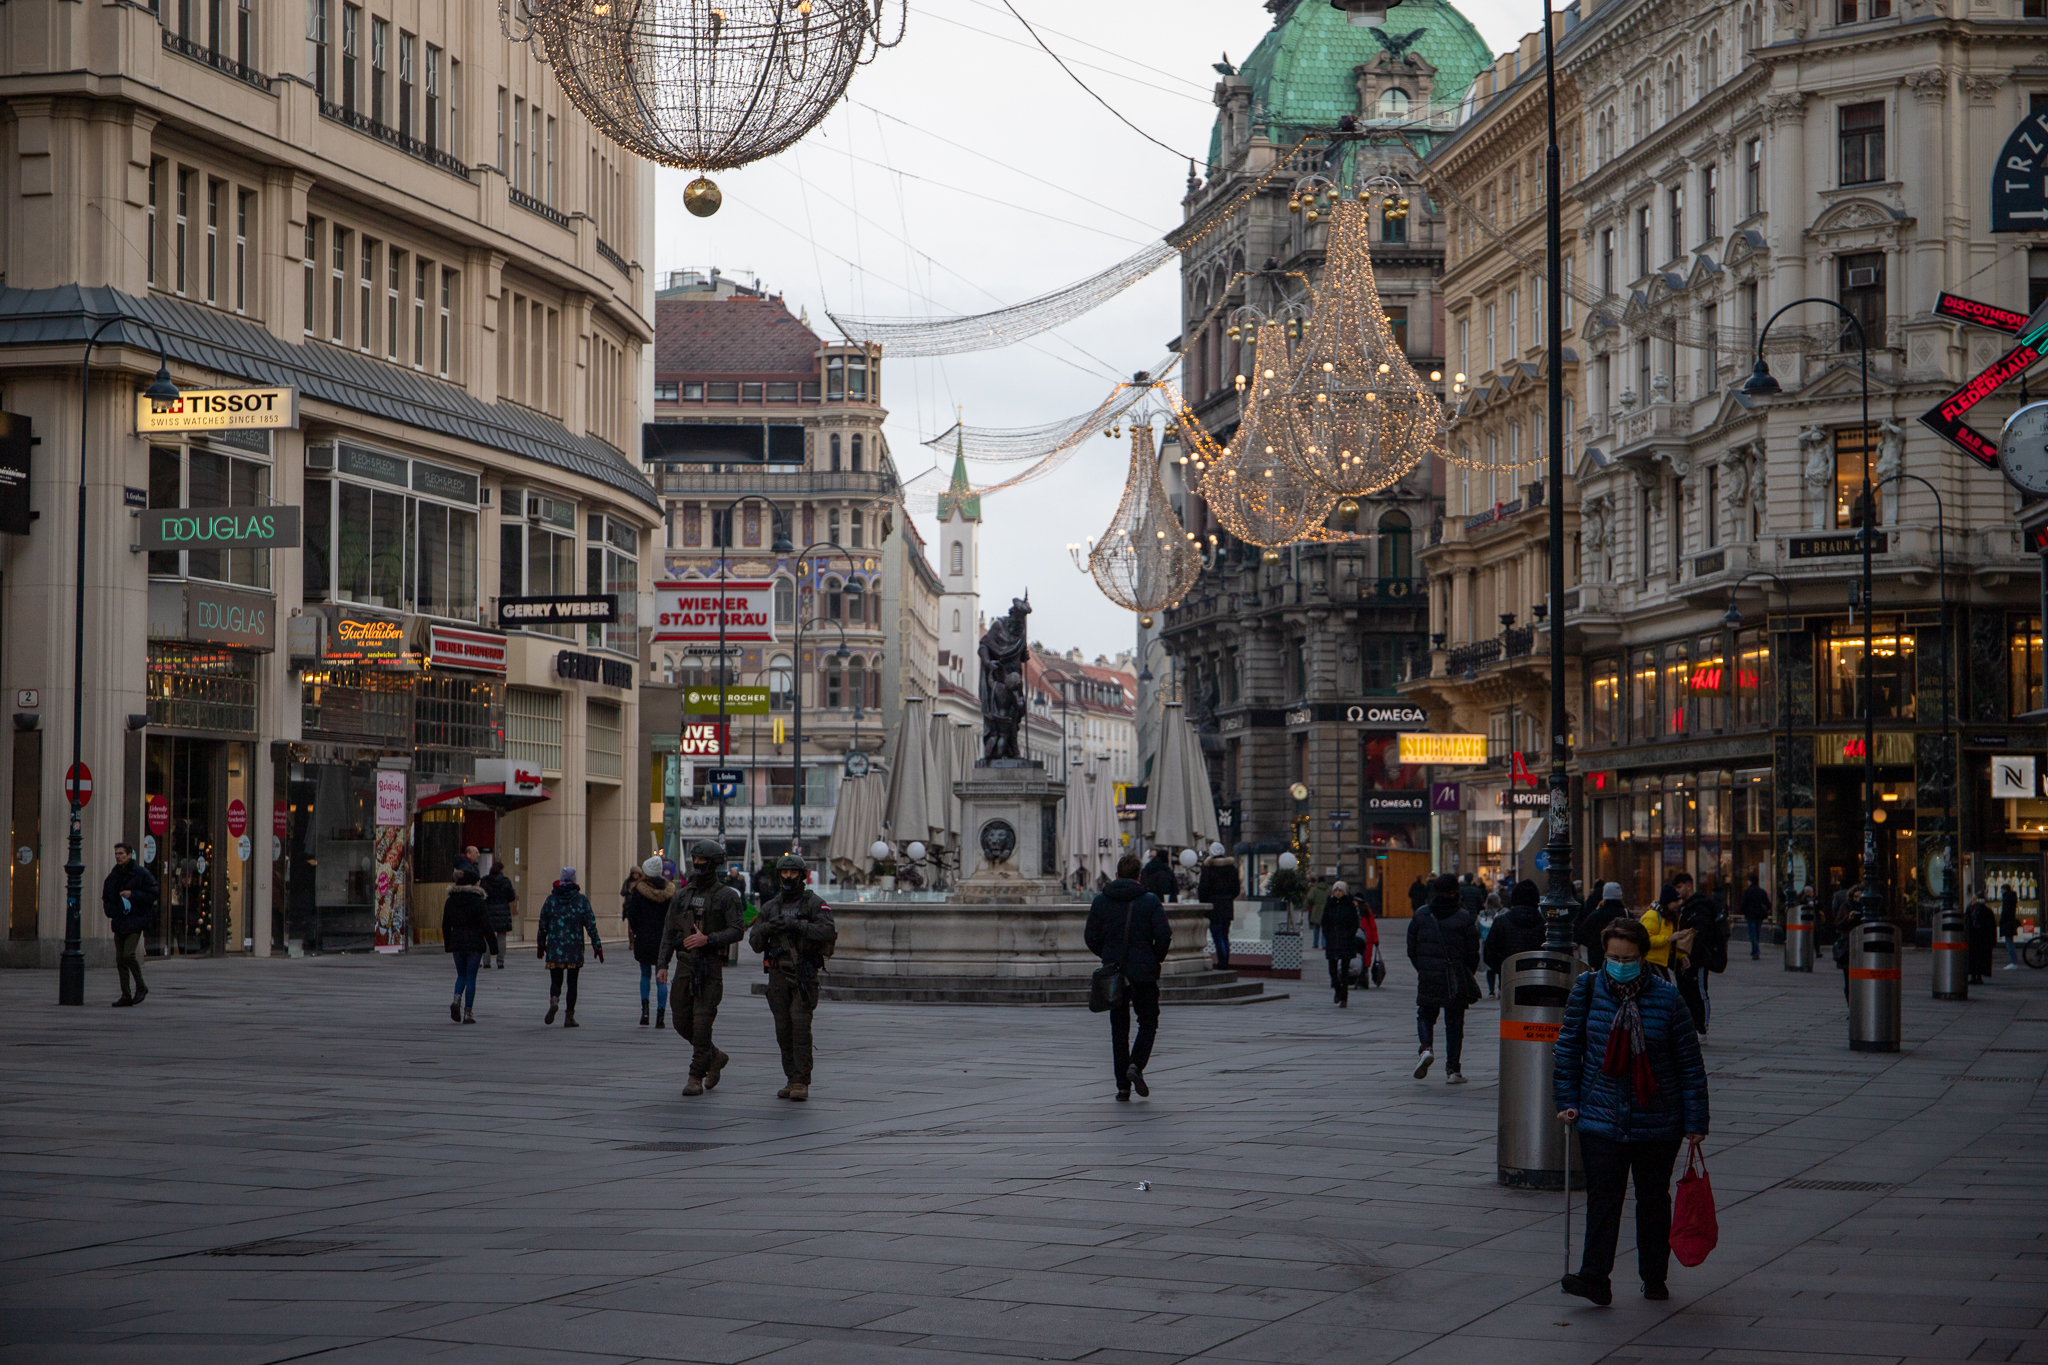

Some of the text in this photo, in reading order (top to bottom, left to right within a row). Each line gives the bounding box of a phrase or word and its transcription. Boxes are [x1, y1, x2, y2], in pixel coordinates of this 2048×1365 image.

[1944, 295, 2030, 327] DISCOTHEQU
[1942, 347, 2038, 422] FLEDERMAUS
[1967, 363, 2000, 390] CABARET
[187, 394, 278, 413] TISSOT
[151, 415, 279, 426] SWISS WATCHES SINCE 1853
[1957, 427, 1982, 449] BAR
[162, 515, 275, 541] DOUGLAS
[1800, 543, 1810, 554] E.
[1813, 540, 1850, 554] BRAUN
[502, 602, 609, 618] GERRY WEBER
[678, 597, 748, 610] WIENER
[198, 601, 265, 636] DOUGLAS
[659, 613, 767, 626] STADTBRÄU
[338, 620, 404, 641] Tuchlauben
[435, 640, 464, 654] WIENER
[557, 649, 632, 690] GERRY WEBER
[1690, 668, 1721, 690] H&M
[25, 691, 31, 702] 2
[727, 694, 766, 702] ROCHER
[1368, 707, 1425, 722] OMEGA
[685, 726, 715, 739] IVE
[680, 739, 720, 753] UYS
[1404, 737, 1482, 757] STURMAYR
[378, 796, 402, 813] Waffeln
[1380, 799, 1412, 808] OMEGA
[1513, 794, 1551, 805] APOTHE
